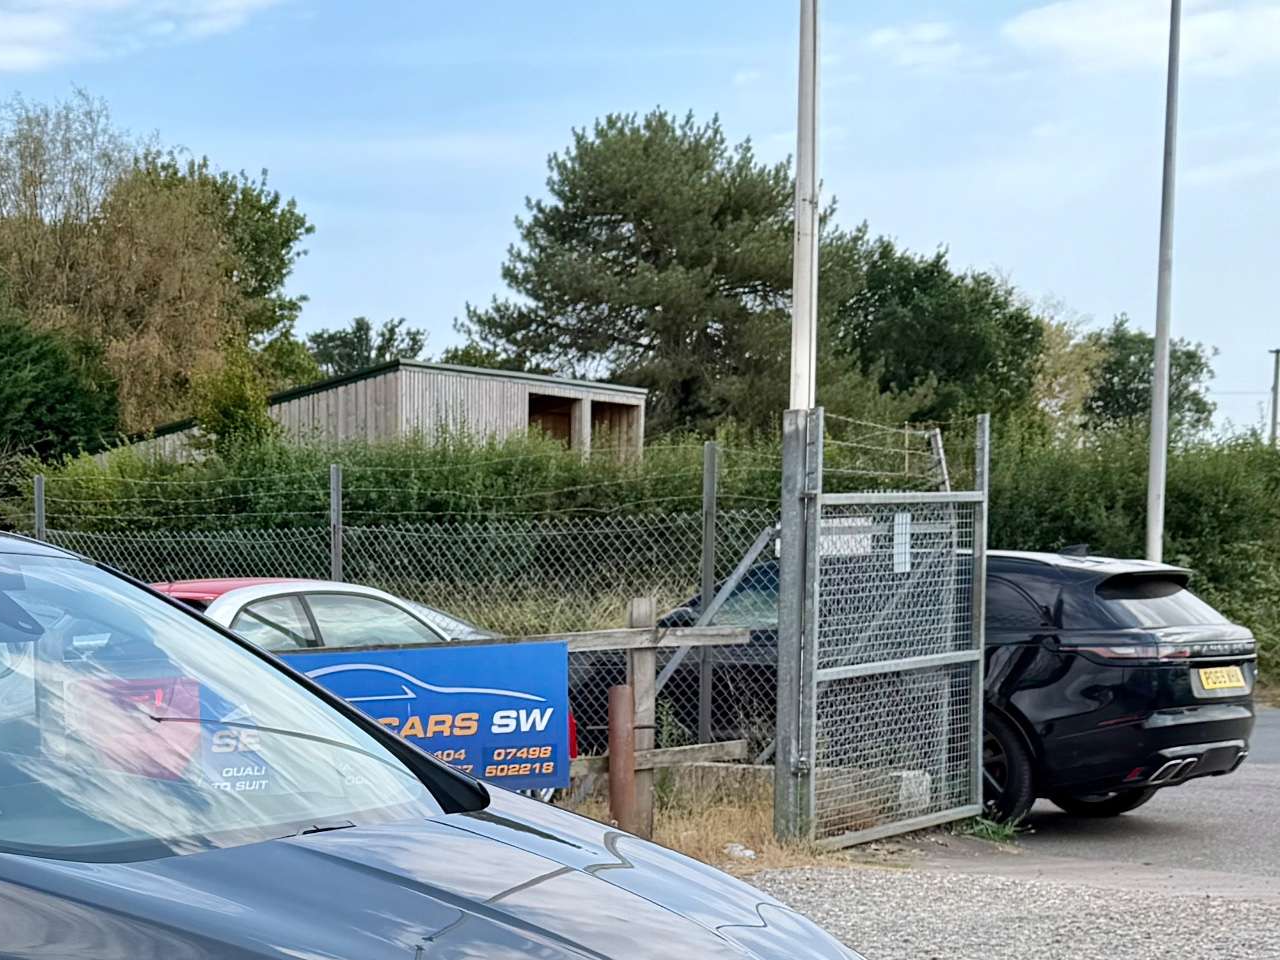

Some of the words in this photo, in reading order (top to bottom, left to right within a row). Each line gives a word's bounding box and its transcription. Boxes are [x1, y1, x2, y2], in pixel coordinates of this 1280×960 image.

[376, 711, 480, 739] CARS
[490, 707, 554, 734] SW
[492, 746, 553, 761] 07498
[222, 766, 266, 778] QUALI
[484, 761, 554, 777] 502218
[235, 780, 269, 792] SUIT
